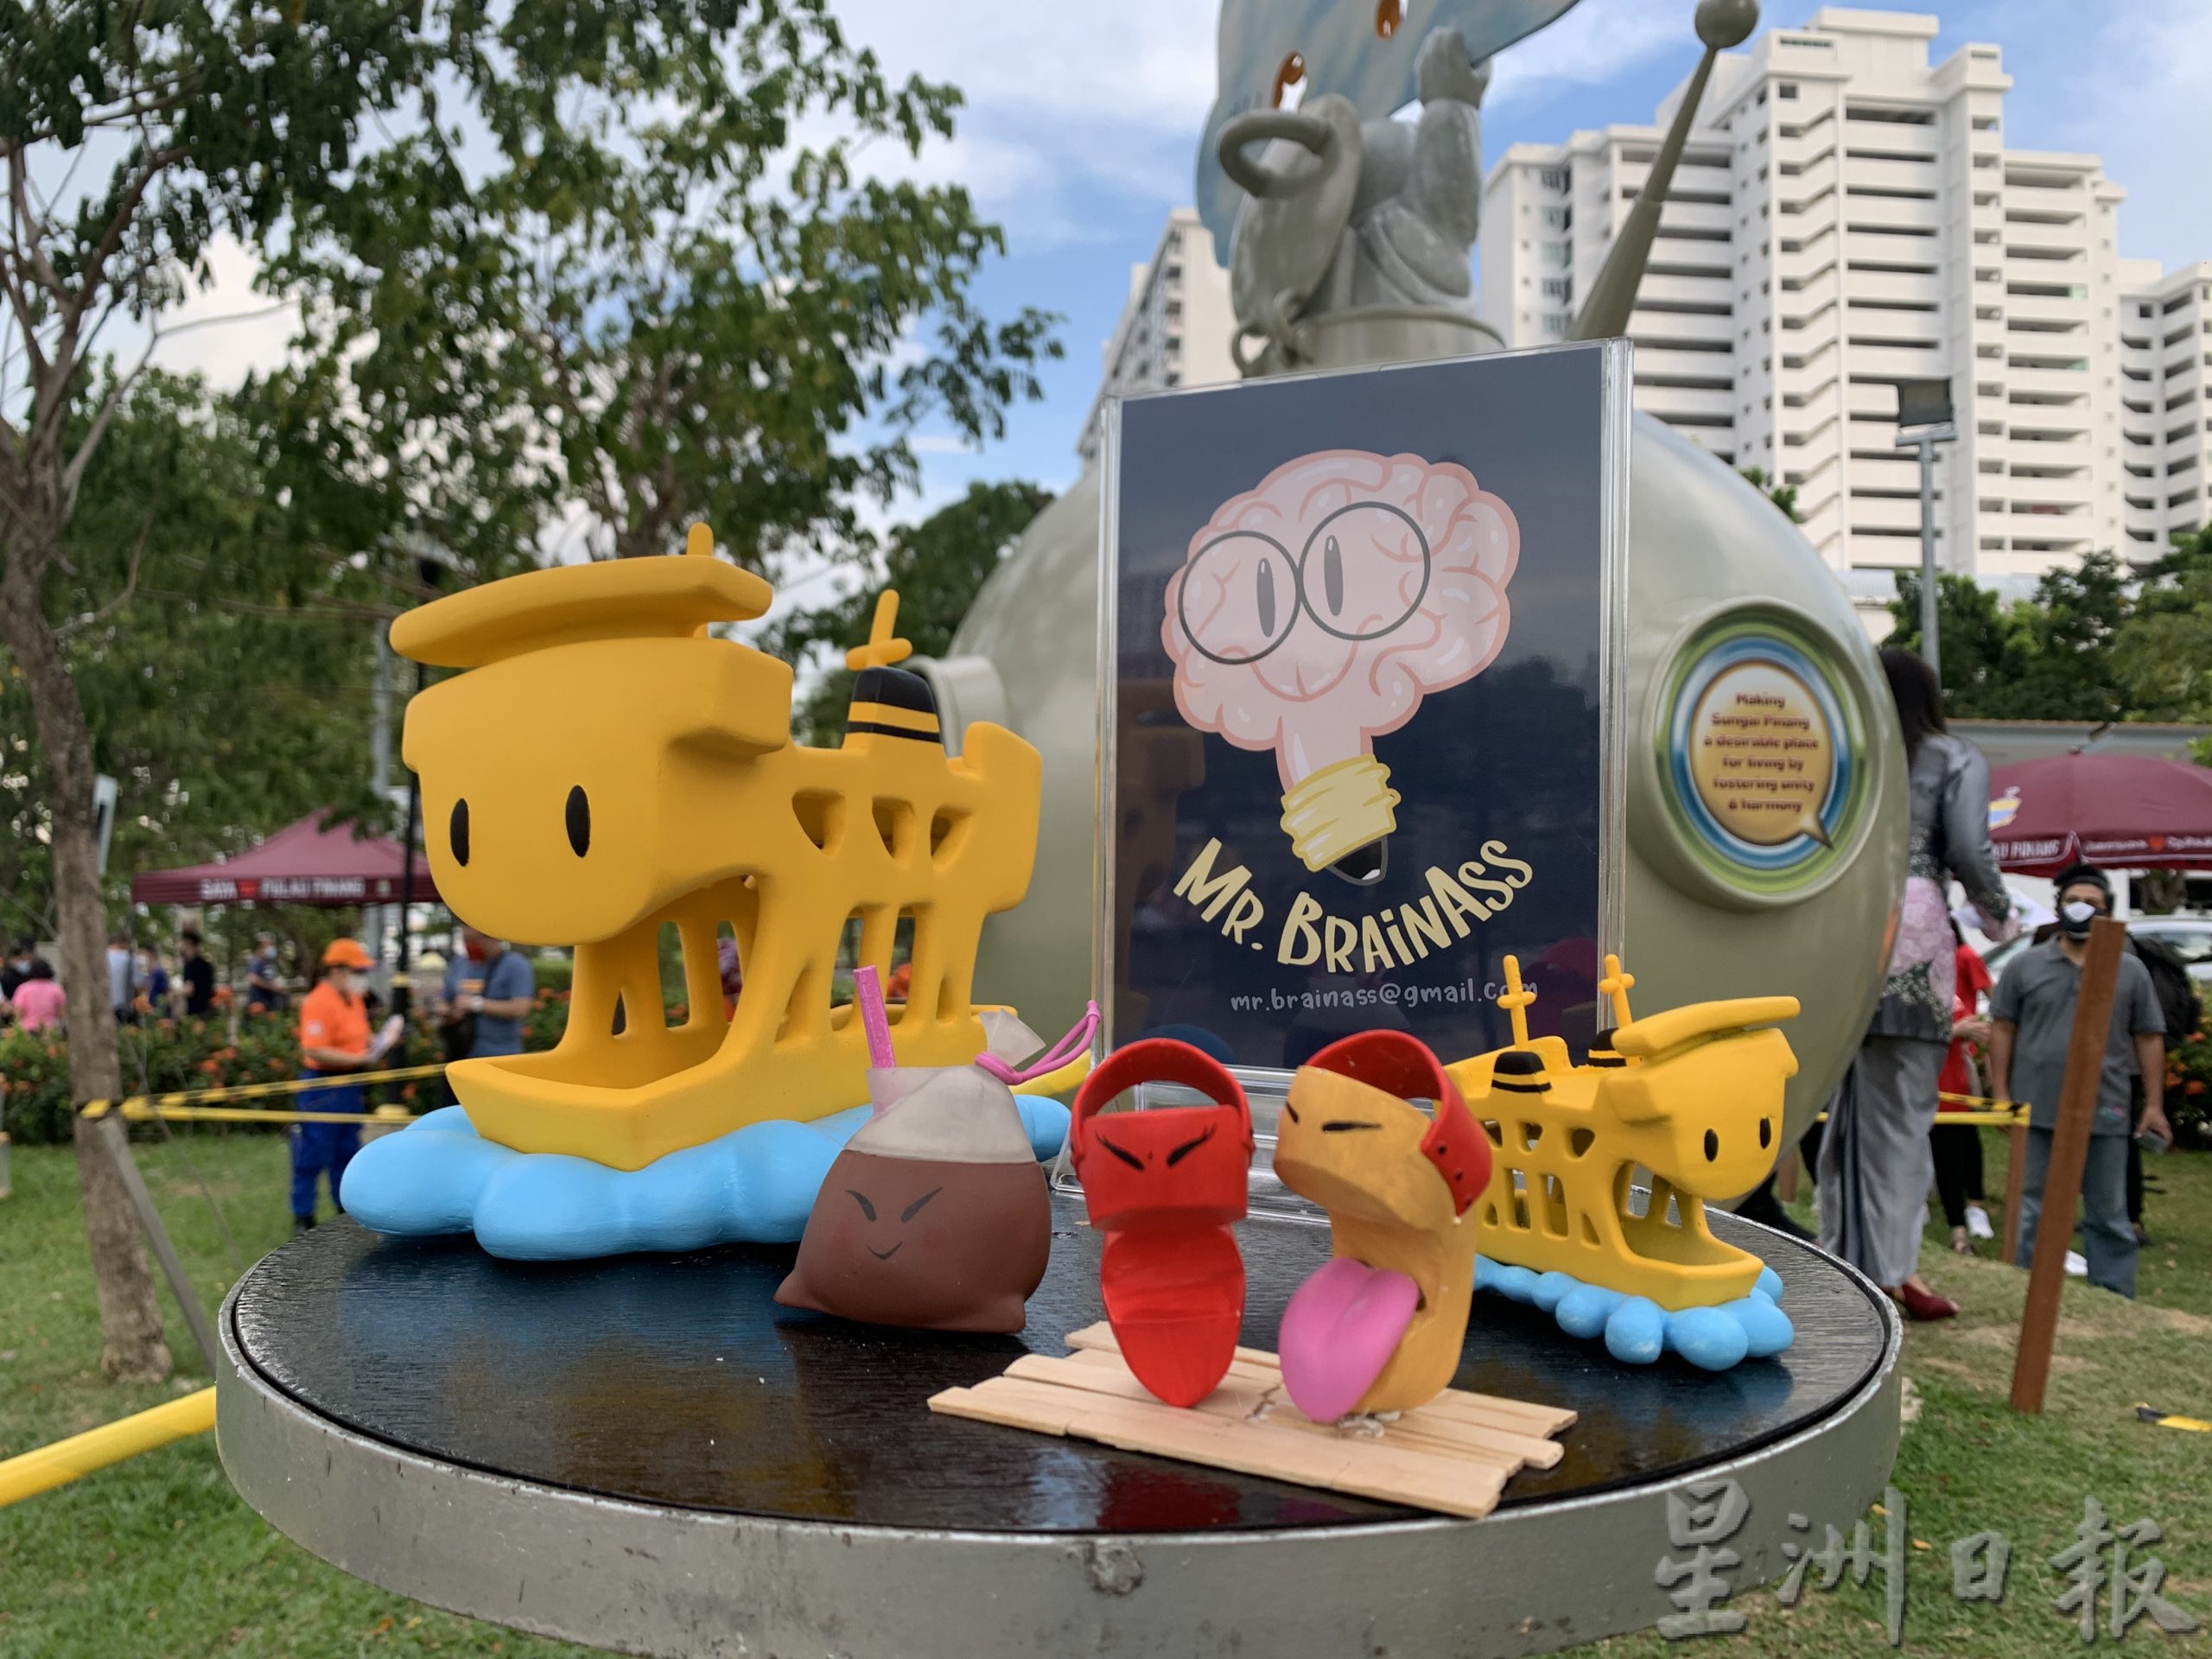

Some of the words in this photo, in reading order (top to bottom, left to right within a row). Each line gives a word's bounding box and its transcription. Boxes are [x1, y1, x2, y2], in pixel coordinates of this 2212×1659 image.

[1736, 692, 1785, 709] Making
[1713, 713, 1760, 729] Sungai
[1764, 714, 1810, 730] Pinang
[1717, 734, 1780, 747] desirable
[1783, 736, 1818, 751] place
[1722, 754, 1742, 767] for
[1748, 754, 1785, 772] living
[1788, 755, 1804, 772] by
[1713, 776, 1777, 793] fostering
[1782, 778, 1815, 793] unity
[1741, 798, 1802, 814] harmony
